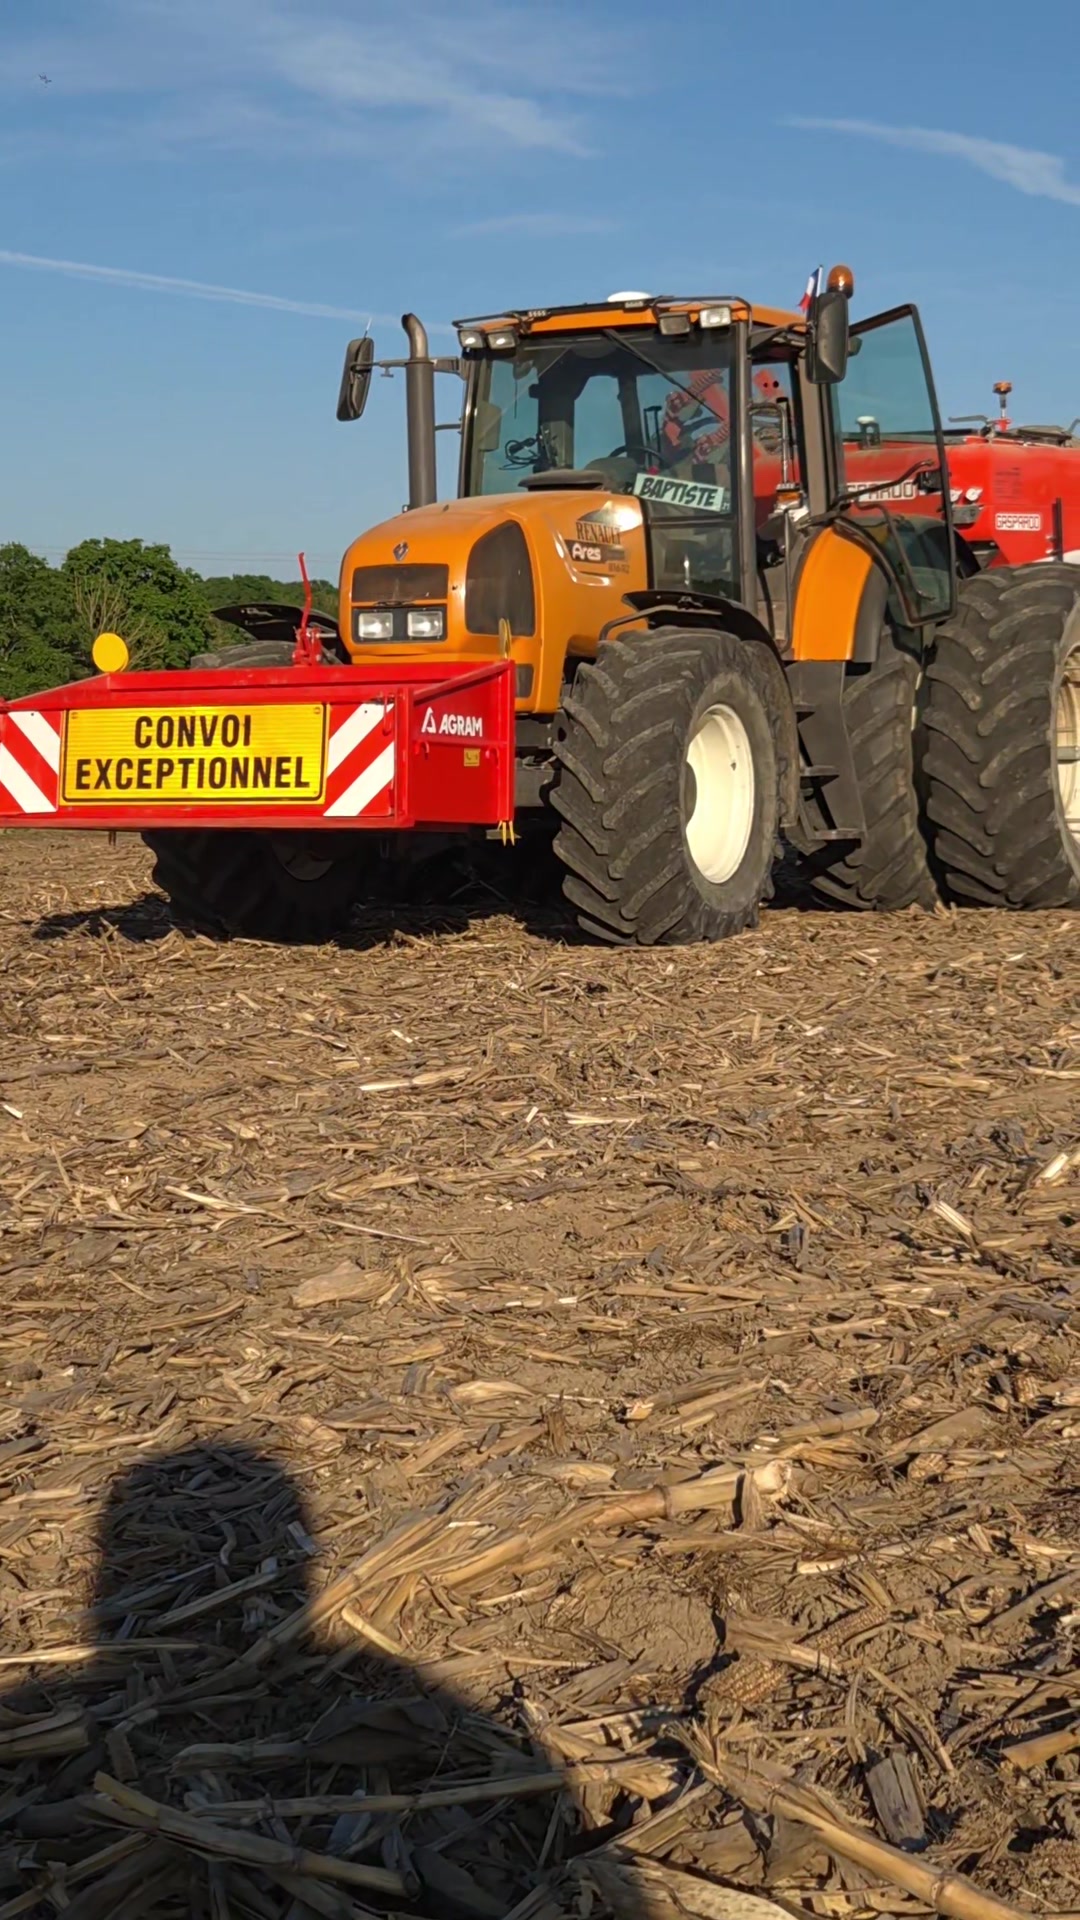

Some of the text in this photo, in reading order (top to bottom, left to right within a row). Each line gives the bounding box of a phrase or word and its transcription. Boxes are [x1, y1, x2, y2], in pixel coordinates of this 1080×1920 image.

[639, 476, 719, 508] BAPTISTE
[575, 520, 621, 546] RENAULT
[571, 543, 602, 562] Ares
[133, 714, 252, 749] CONVOI
[438, 713, 483, 737] AGRAM
[74, 755, 311, 791] EXCEPTIONNEL
